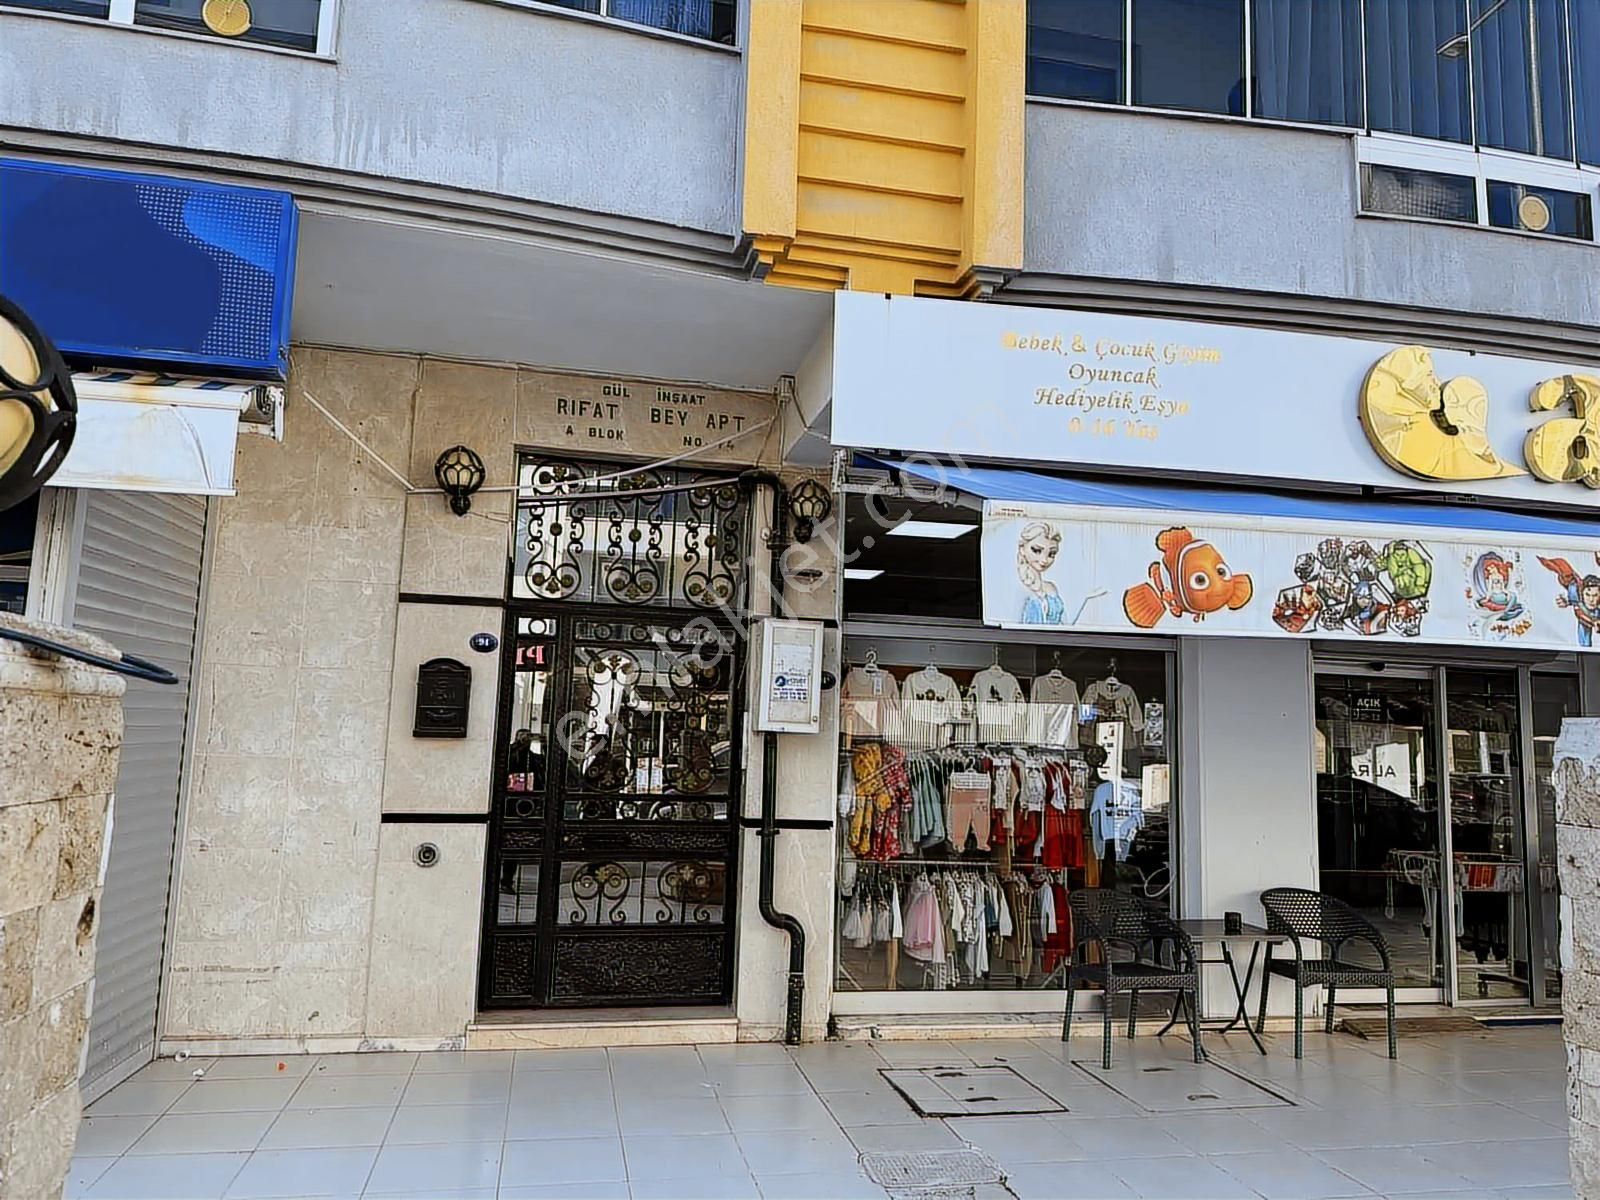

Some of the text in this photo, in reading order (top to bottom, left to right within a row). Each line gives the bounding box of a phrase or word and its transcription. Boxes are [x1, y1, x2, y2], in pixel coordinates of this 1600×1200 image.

[1071, 334, 1087, 353] &
[1095, 337, 1161, 362] Çocuk
[1069, 363, 1162, 388] Oyuncak
[602, 384, 630, 398] GÜL
[1033, 388, 1138, 414] Hediyelik
[557, 399, 746, 432] RIFAT BEY APT
[566, 425, 574, 436] A
[589, 427, 625, 441] BLOK
